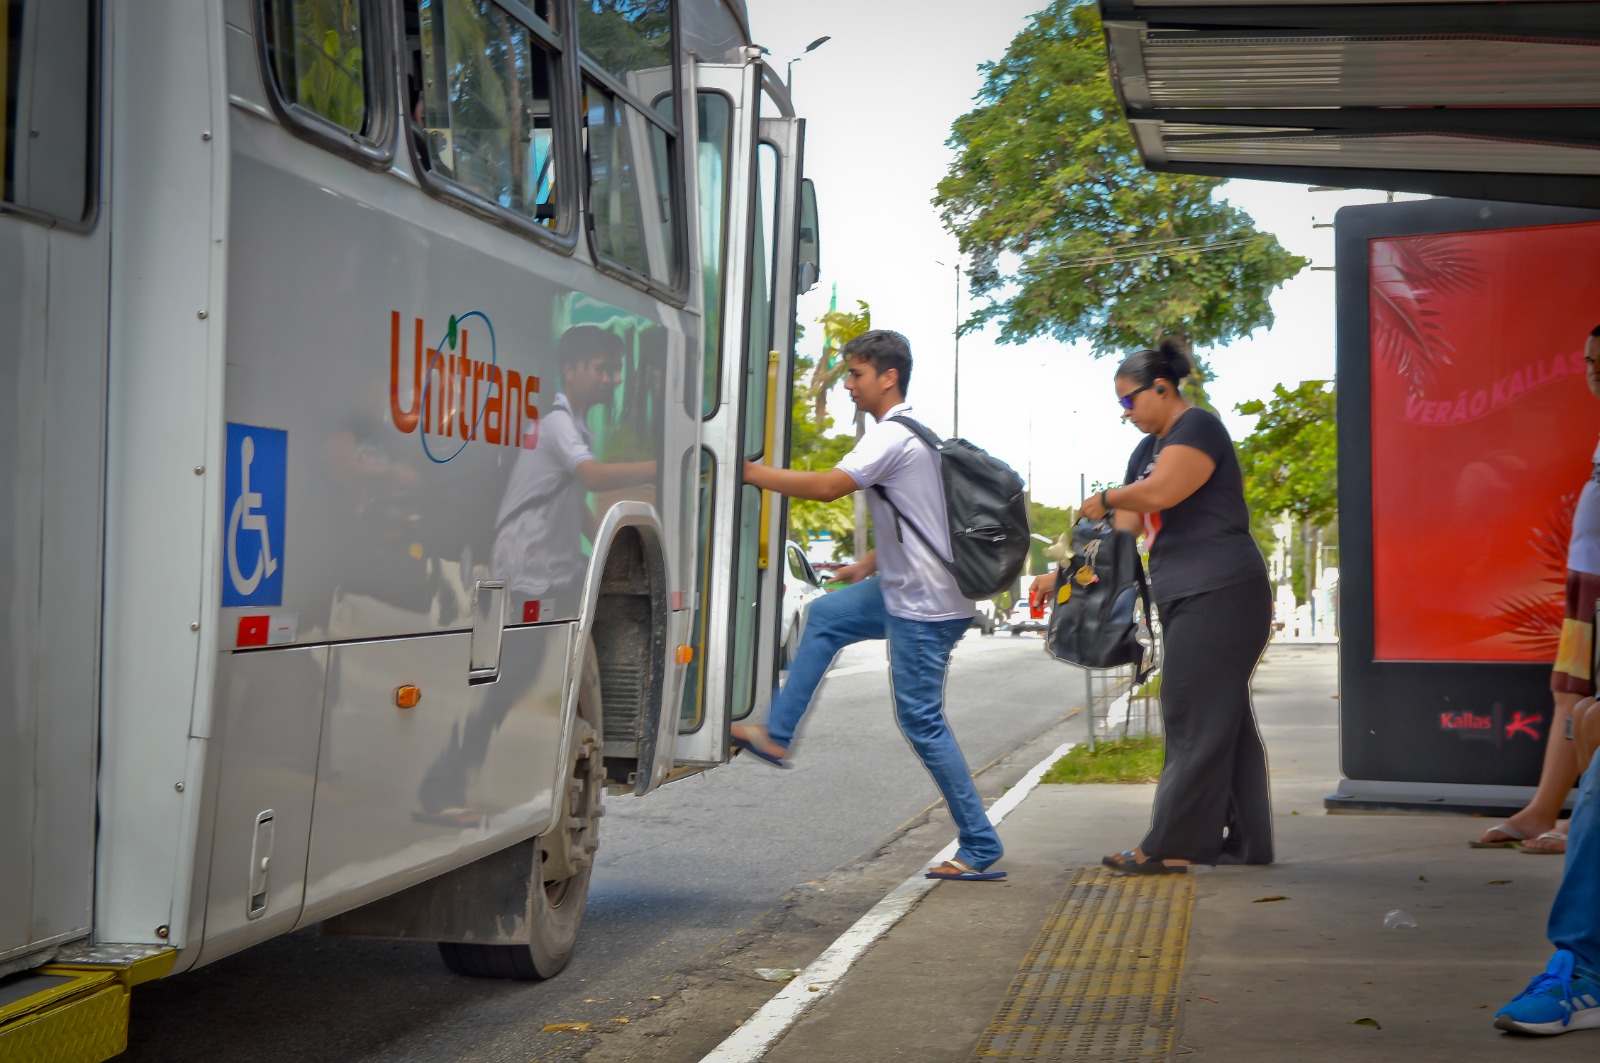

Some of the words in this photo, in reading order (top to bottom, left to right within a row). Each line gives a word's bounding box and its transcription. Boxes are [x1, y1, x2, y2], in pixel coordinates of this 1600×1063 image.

[390, 310, 540, 451] Unitrans
[1491, 350, 1586, 408] KALLAS
[1440, 711, 1492, 730] Kallas
